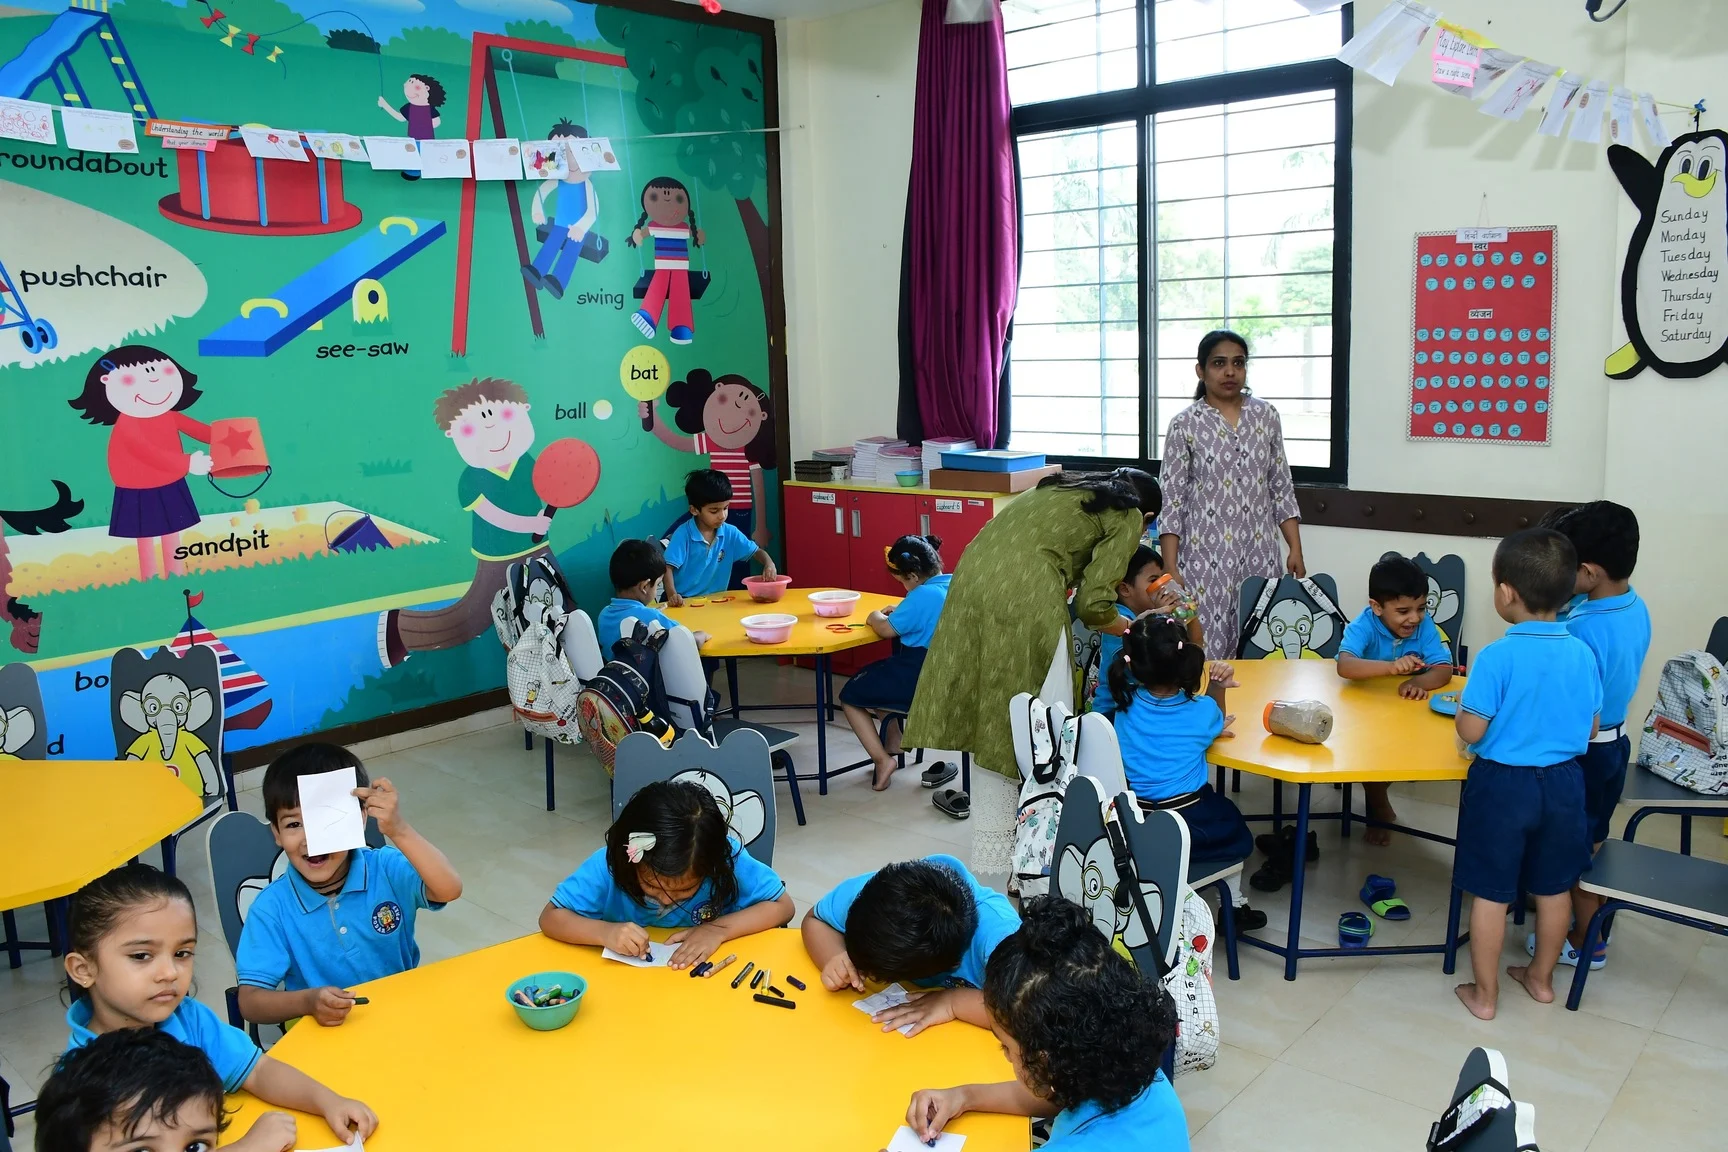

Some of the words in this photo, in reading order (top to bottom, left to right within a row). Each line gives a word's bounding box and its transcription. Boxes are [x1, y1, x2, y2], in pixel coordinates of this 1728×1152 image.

[152, 122, 188, 138] Understanding
[192, 128, 202, 136] the
[1661, 208, 1708, 223] Sunday
[1661, 228, 1706, 243] Monday
[1660, 247, 1710, 263] Tuesday
[20, 264, 167, 292] pushchair
[1661, 266, 1719, 282] Wednesday
[576, 288, 624, 310] swing
[1661, 287, 1712, 304] Thursday
[1663, 308, 1703, 324] Friday
[1660, 328, 1712, 344] Saturday
[316, 342, 409, 358] see-saw
[630, 365, 658, 380] bat
[555, 402, 586, 420] ball
[174, 529, 269, 560] sandpit
[75, 671, 109, 692] bo
